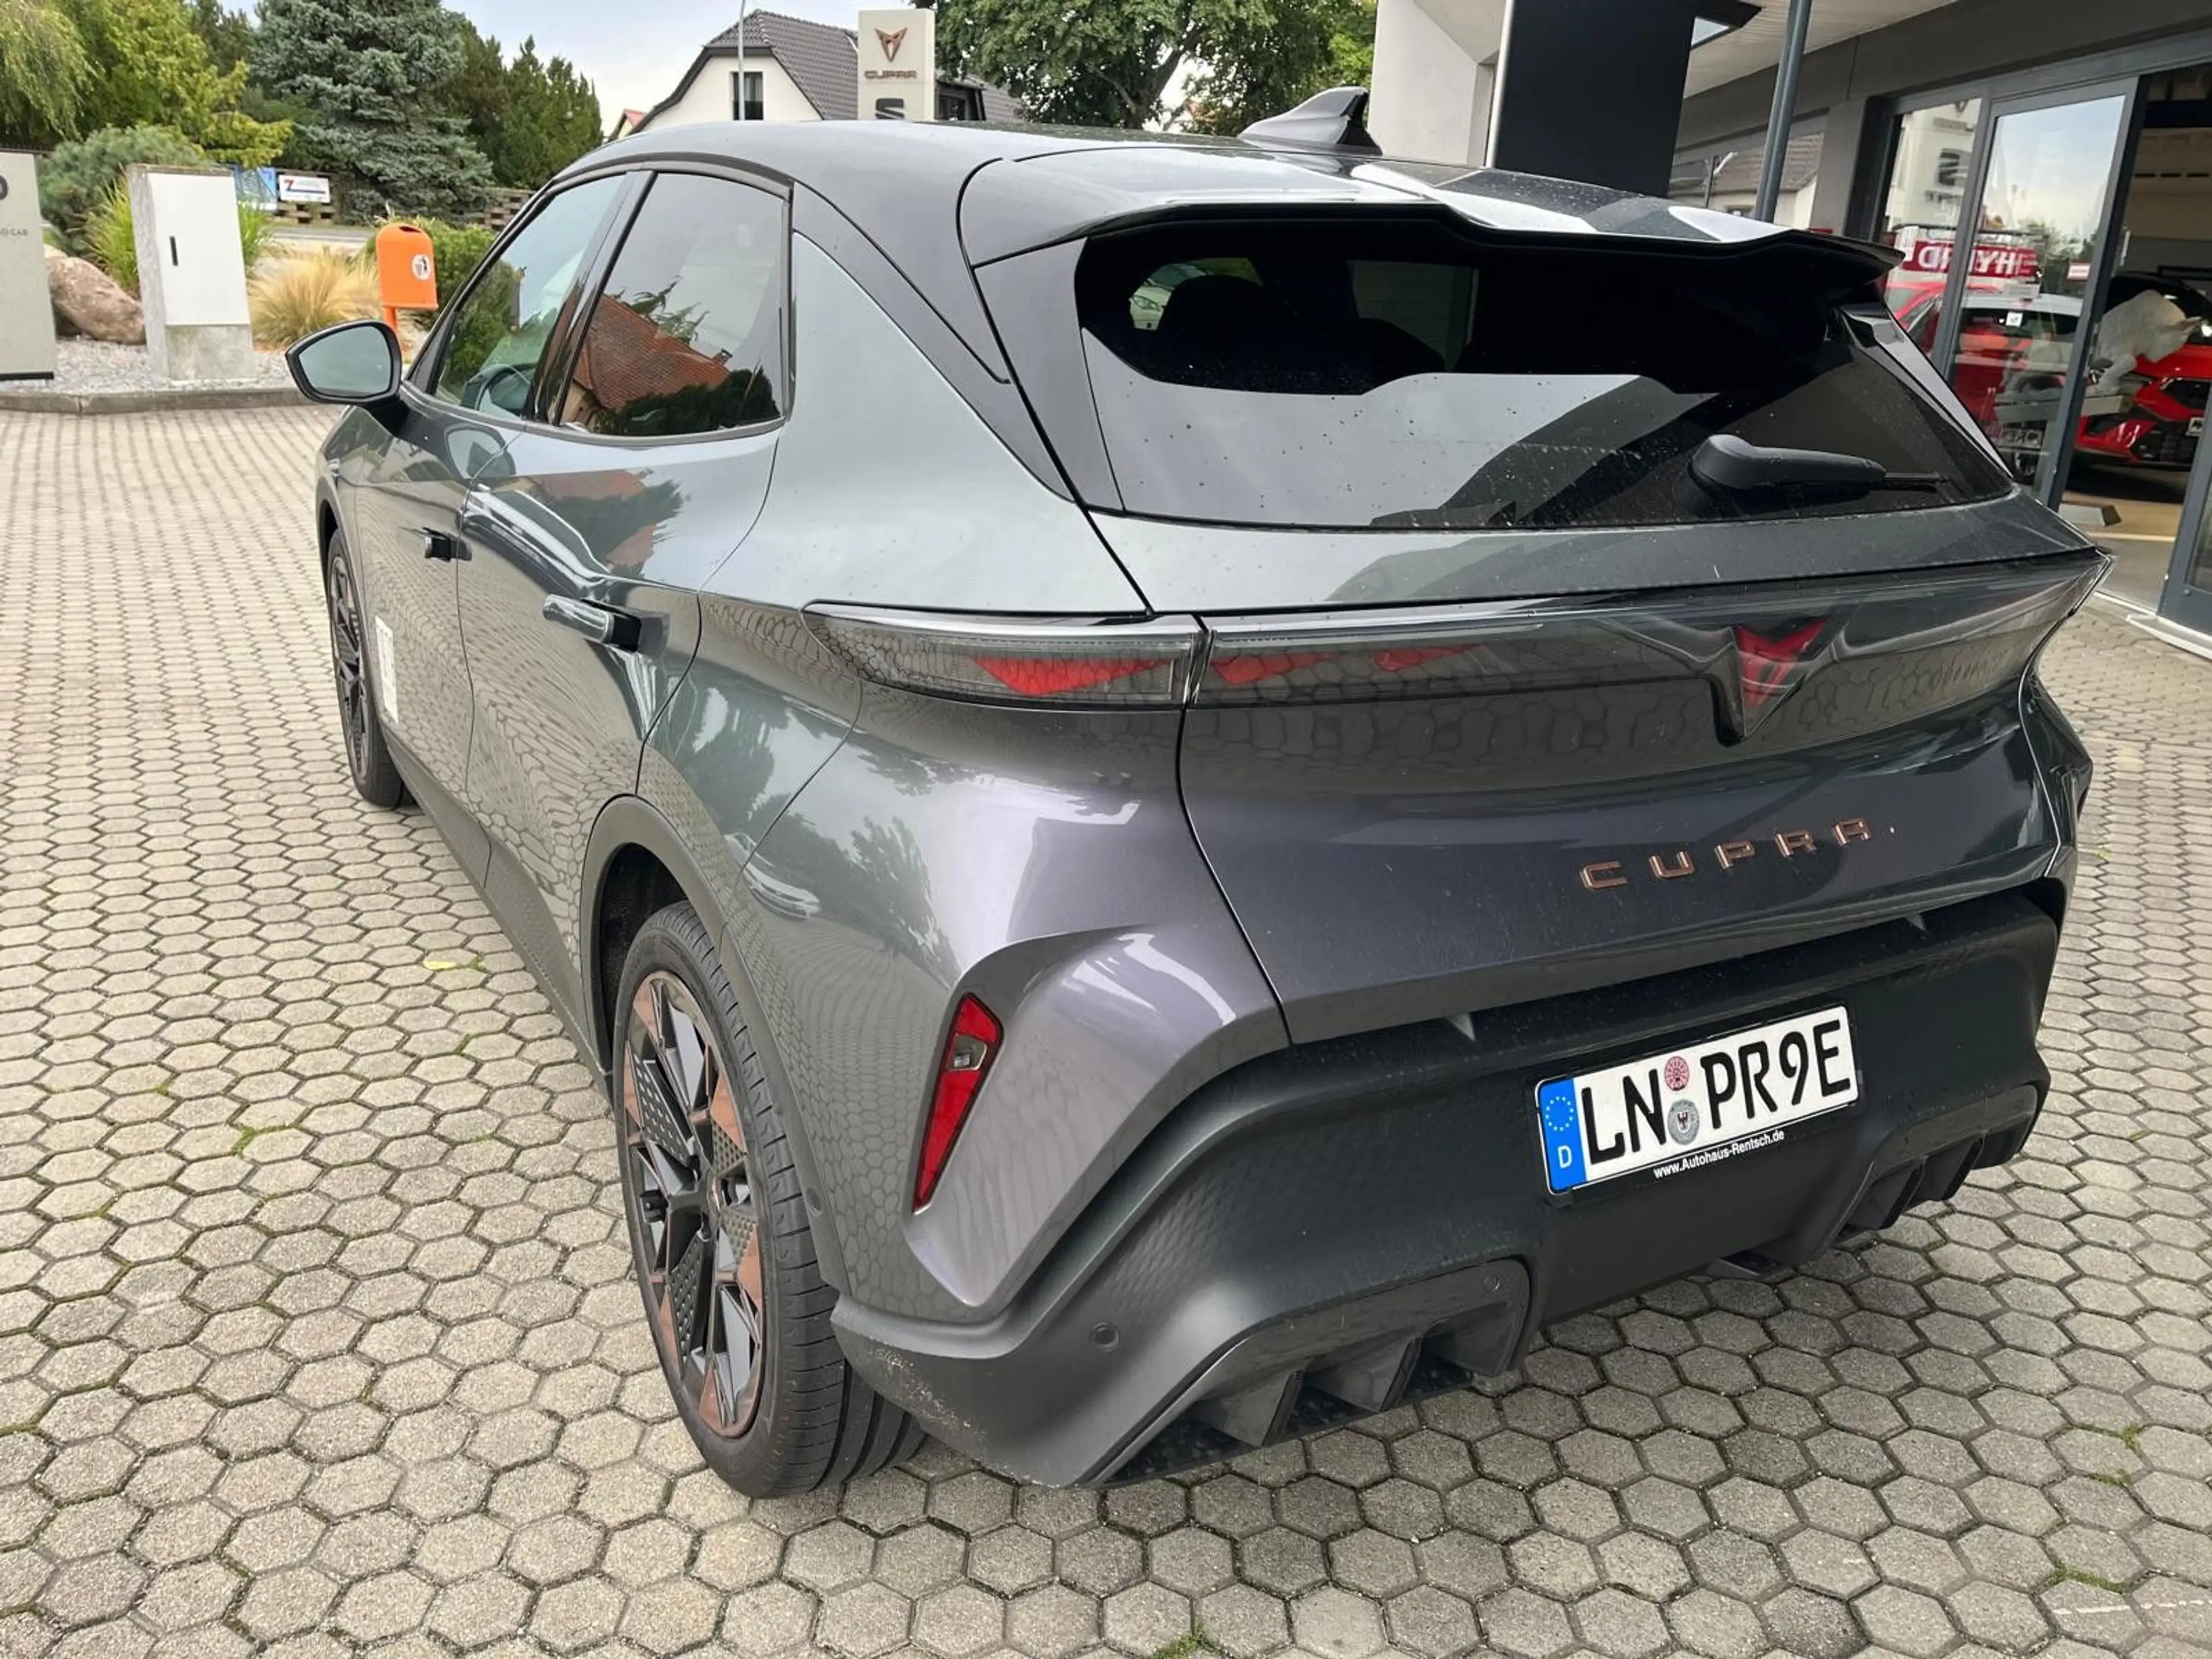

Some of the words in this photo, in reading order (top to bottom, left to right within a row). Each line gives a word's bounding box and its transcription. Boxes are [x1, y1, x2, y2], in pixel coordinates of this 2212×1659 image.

[864, 70, 917, 79] CUPRA
[1580, 818, 1872, 891] CUPRA
[1581, 1068, 1666, 1165] LN
[1700, 1019, 1851, 1130] PR9E
[1558, 1145, 1573, 1169] D
[1653, 1130, 1785, 1179] www.Autohaus-Rentsch.de
